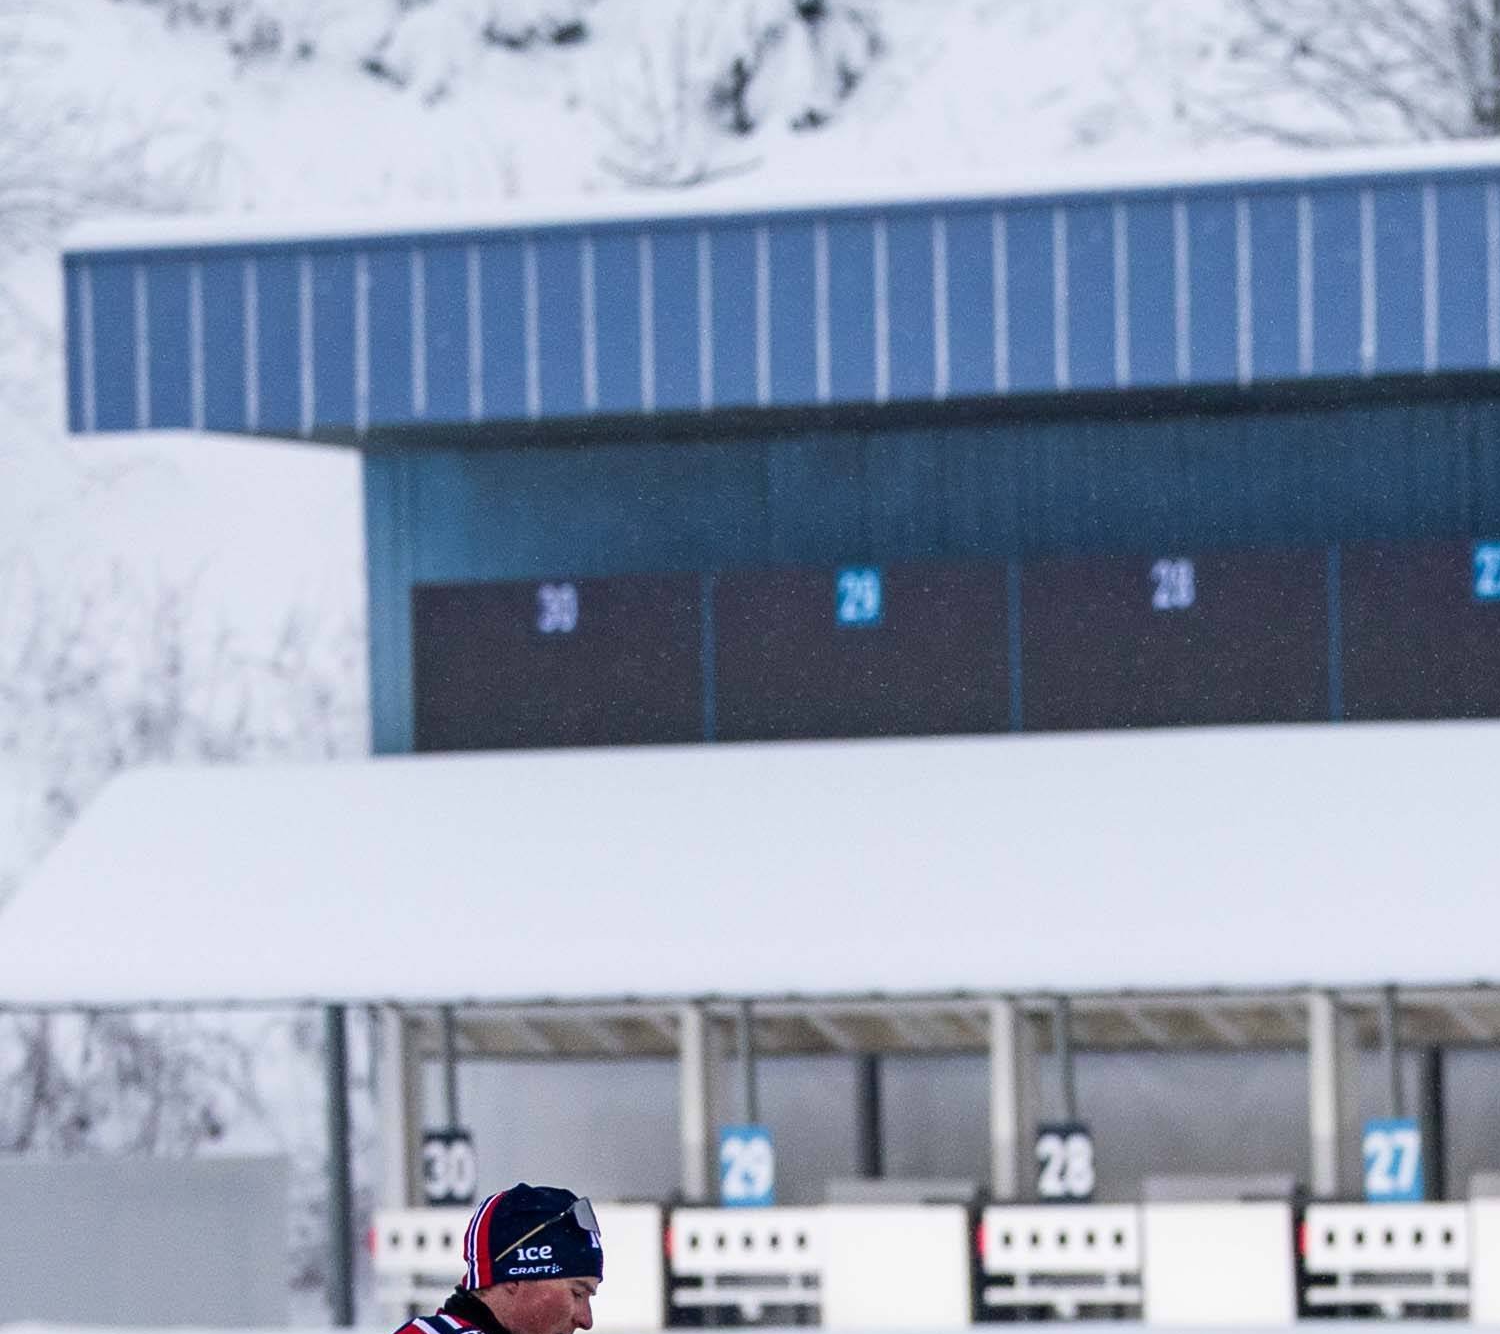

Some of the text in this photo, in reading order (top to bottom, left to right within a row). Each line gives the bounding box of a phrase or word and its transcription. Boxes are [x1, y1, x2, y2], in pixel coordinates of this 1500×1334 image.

[425, 1141, 476, 1199] 30
[720, 1137, 775, 1201] 29
[1037, 1134, 1095, 1199] 28
[1364, 1129, 1421, 1196] 27
[508, 1265, 550, 1275] CRAFT
[518, 1245, 552, 1261] ice
